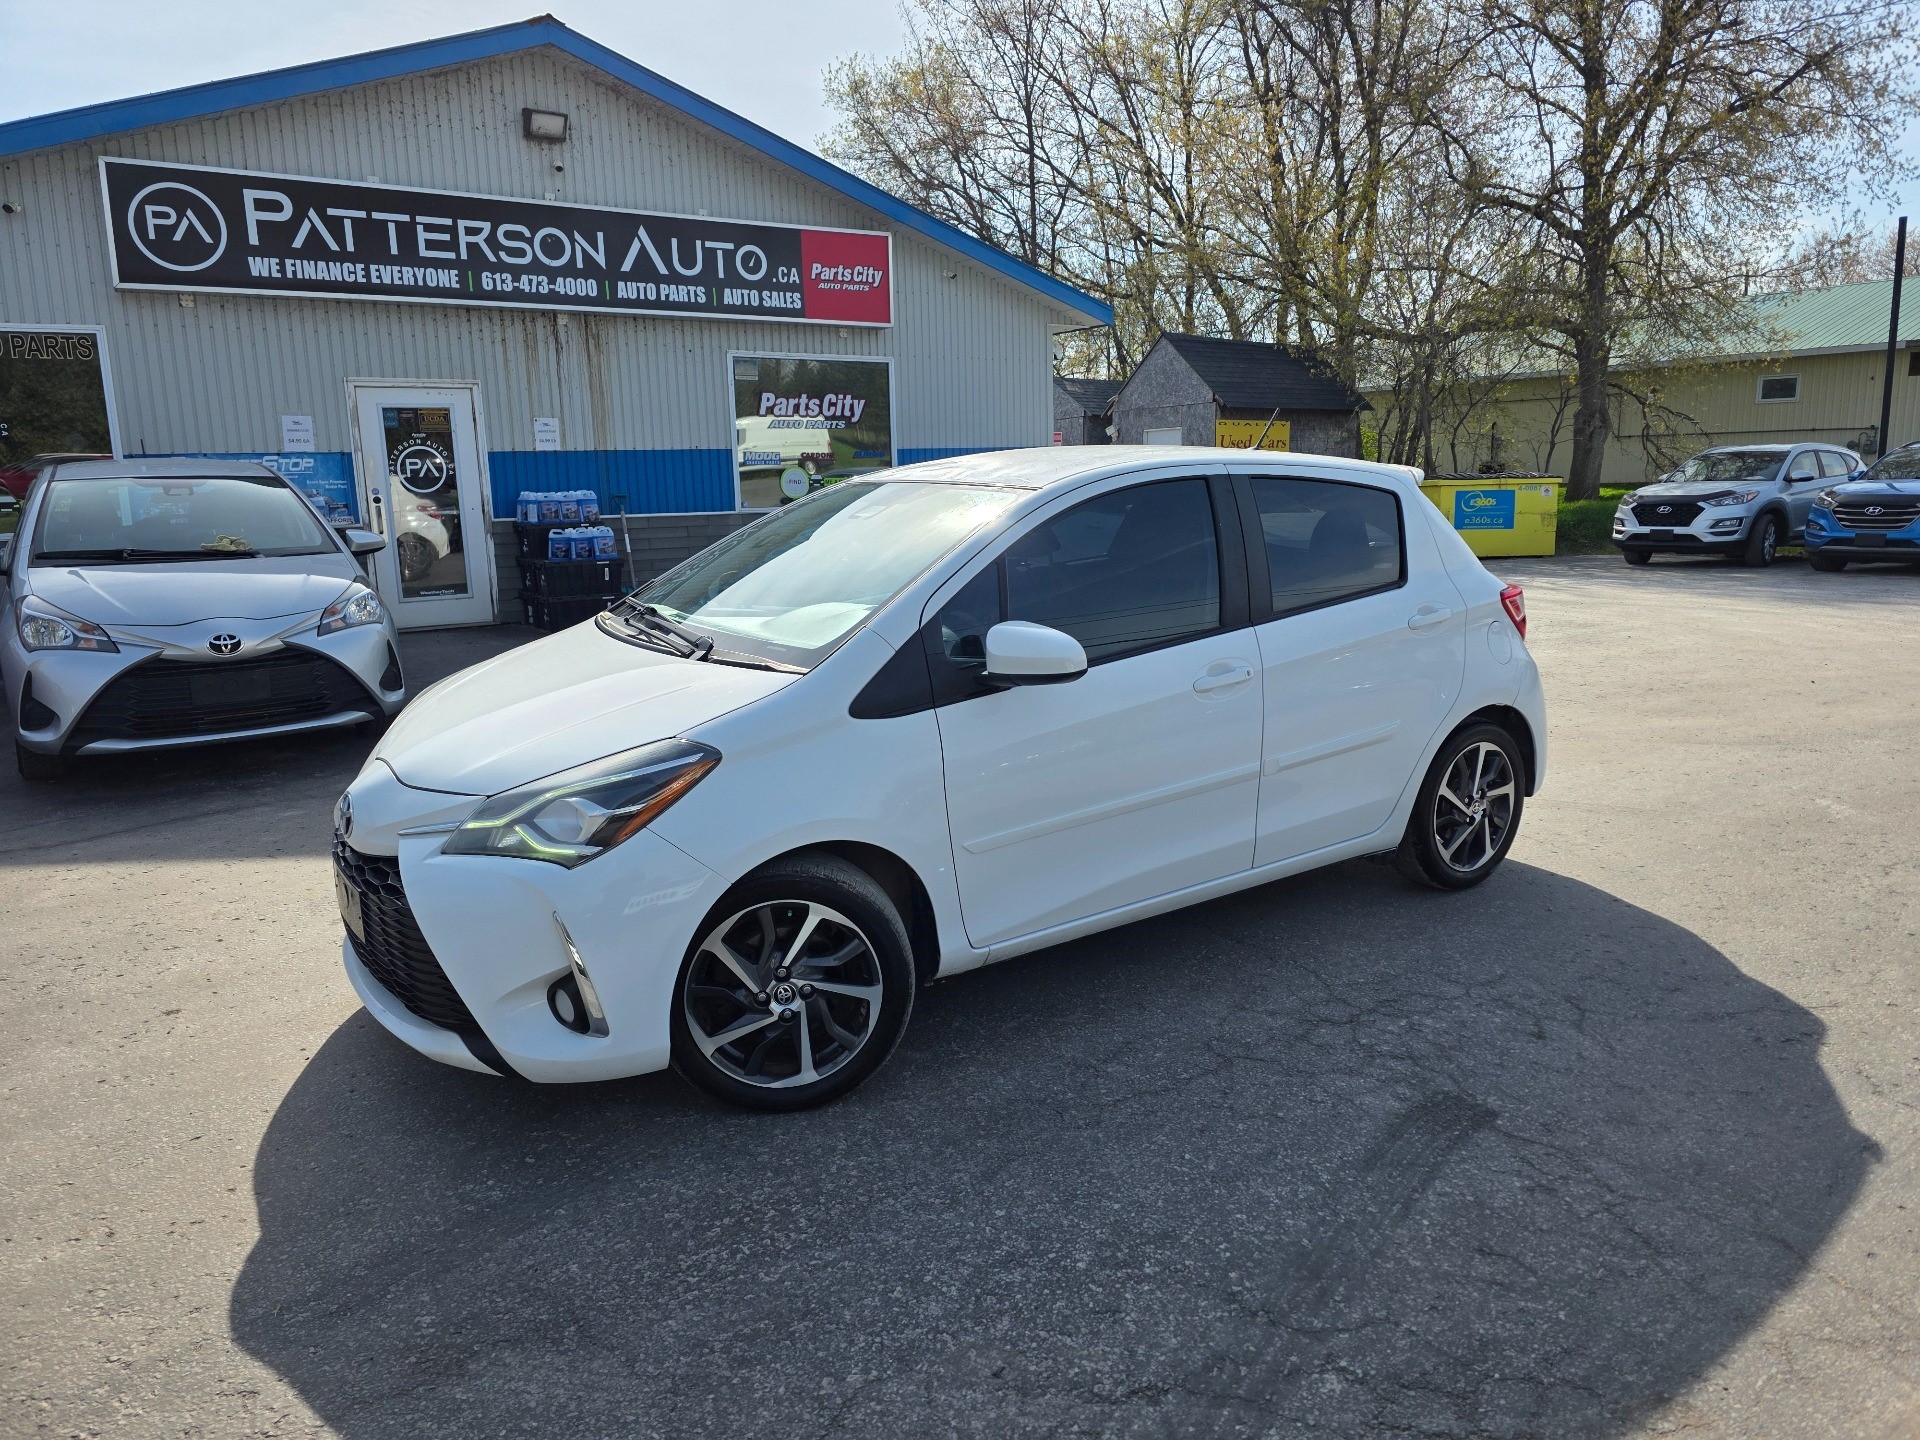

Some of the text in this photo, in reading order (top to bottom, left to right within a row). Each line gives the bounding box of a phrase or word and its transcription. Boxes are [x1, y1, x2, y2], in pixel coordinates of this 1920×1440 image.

[242, 188, 605, 270] PATTERSON
[247, 256, 802, 309] WE FINANCE EVERYONE 613-473-4000 AUTO PARTS AUTO SALES
[818, 281, 870, 292] AUTO PARTS
[8, 333, 94, 360] PARTS
[768, 420, 846, 429] AUTO PARTS
[1220, 434, 1253, 449] Used
[744, 452, 781, 461] MOOG
[1464, 516, 1503, 524] e360s.ca
